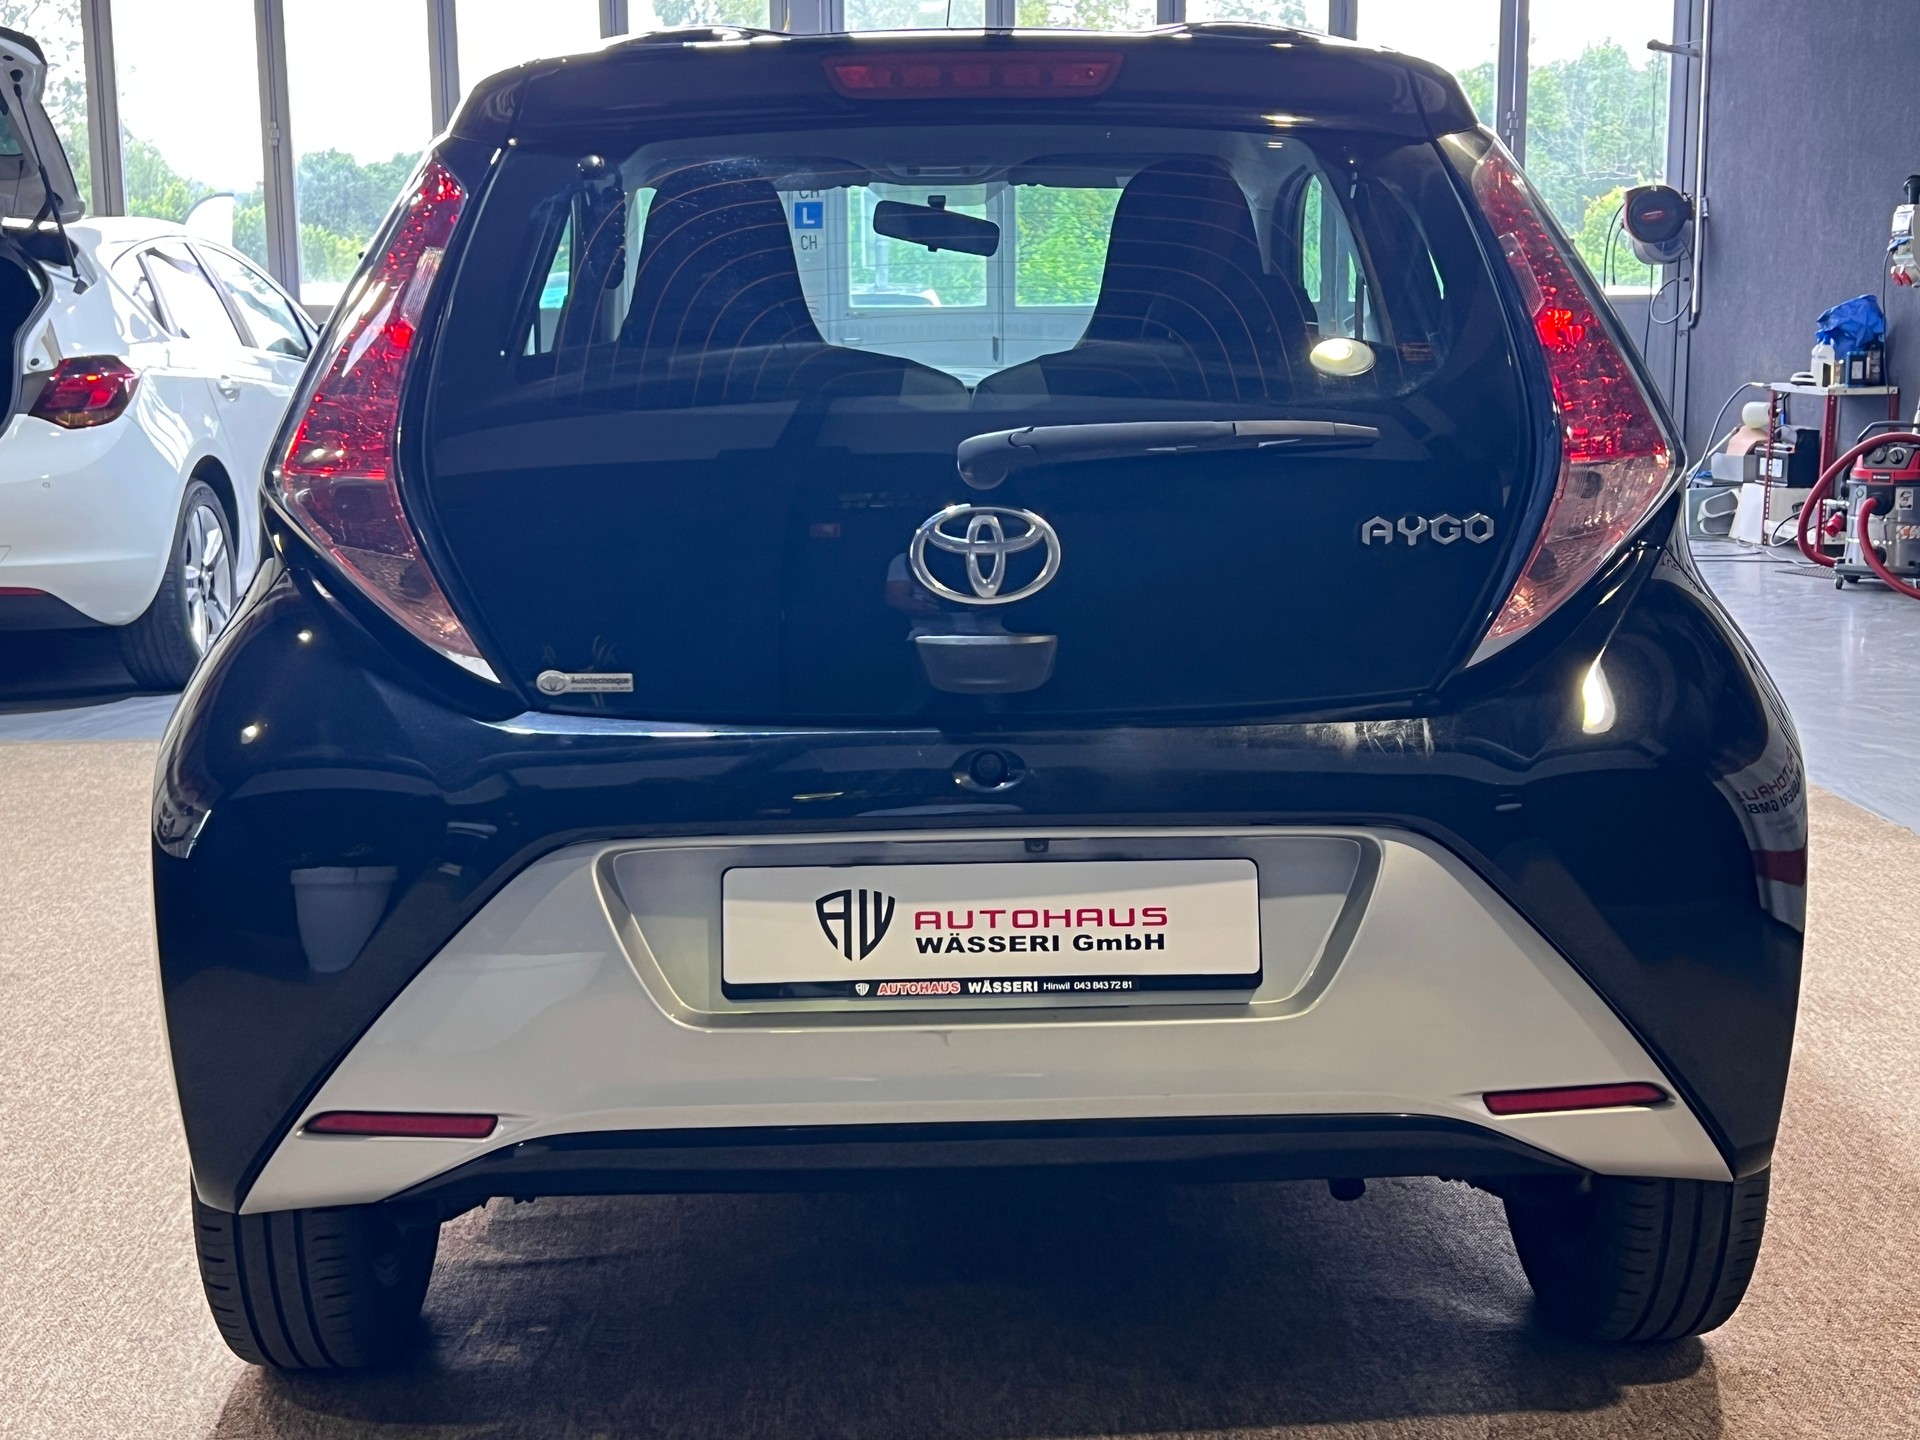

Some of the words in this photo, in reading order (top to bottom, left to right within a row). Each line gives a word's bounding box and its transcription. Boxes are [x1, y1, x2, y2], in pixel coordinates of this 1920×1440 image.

[802, 207, 815, 224] L
[800, 235, 818, 251] CH
[1362, 512, 1495, 546] AYGO
[915, 907, 1168, 930] AUTOHAUS
[915, 933, 1060, 954] WÄSSERI
[1072, 933, 1165, 952] GmbH
[877, 981, 961, 996] AUTOHAUS
[967, 980, 1039, 994] WÄSSERI
[1043, 981, 1071, 991] Hinwil
[1073, 981, 1091, 990] 043
[1092, 981, 1109, 990] 843
[1110, 980, 1121, 989] 72
[1122, 980, 1133, 989] 81
